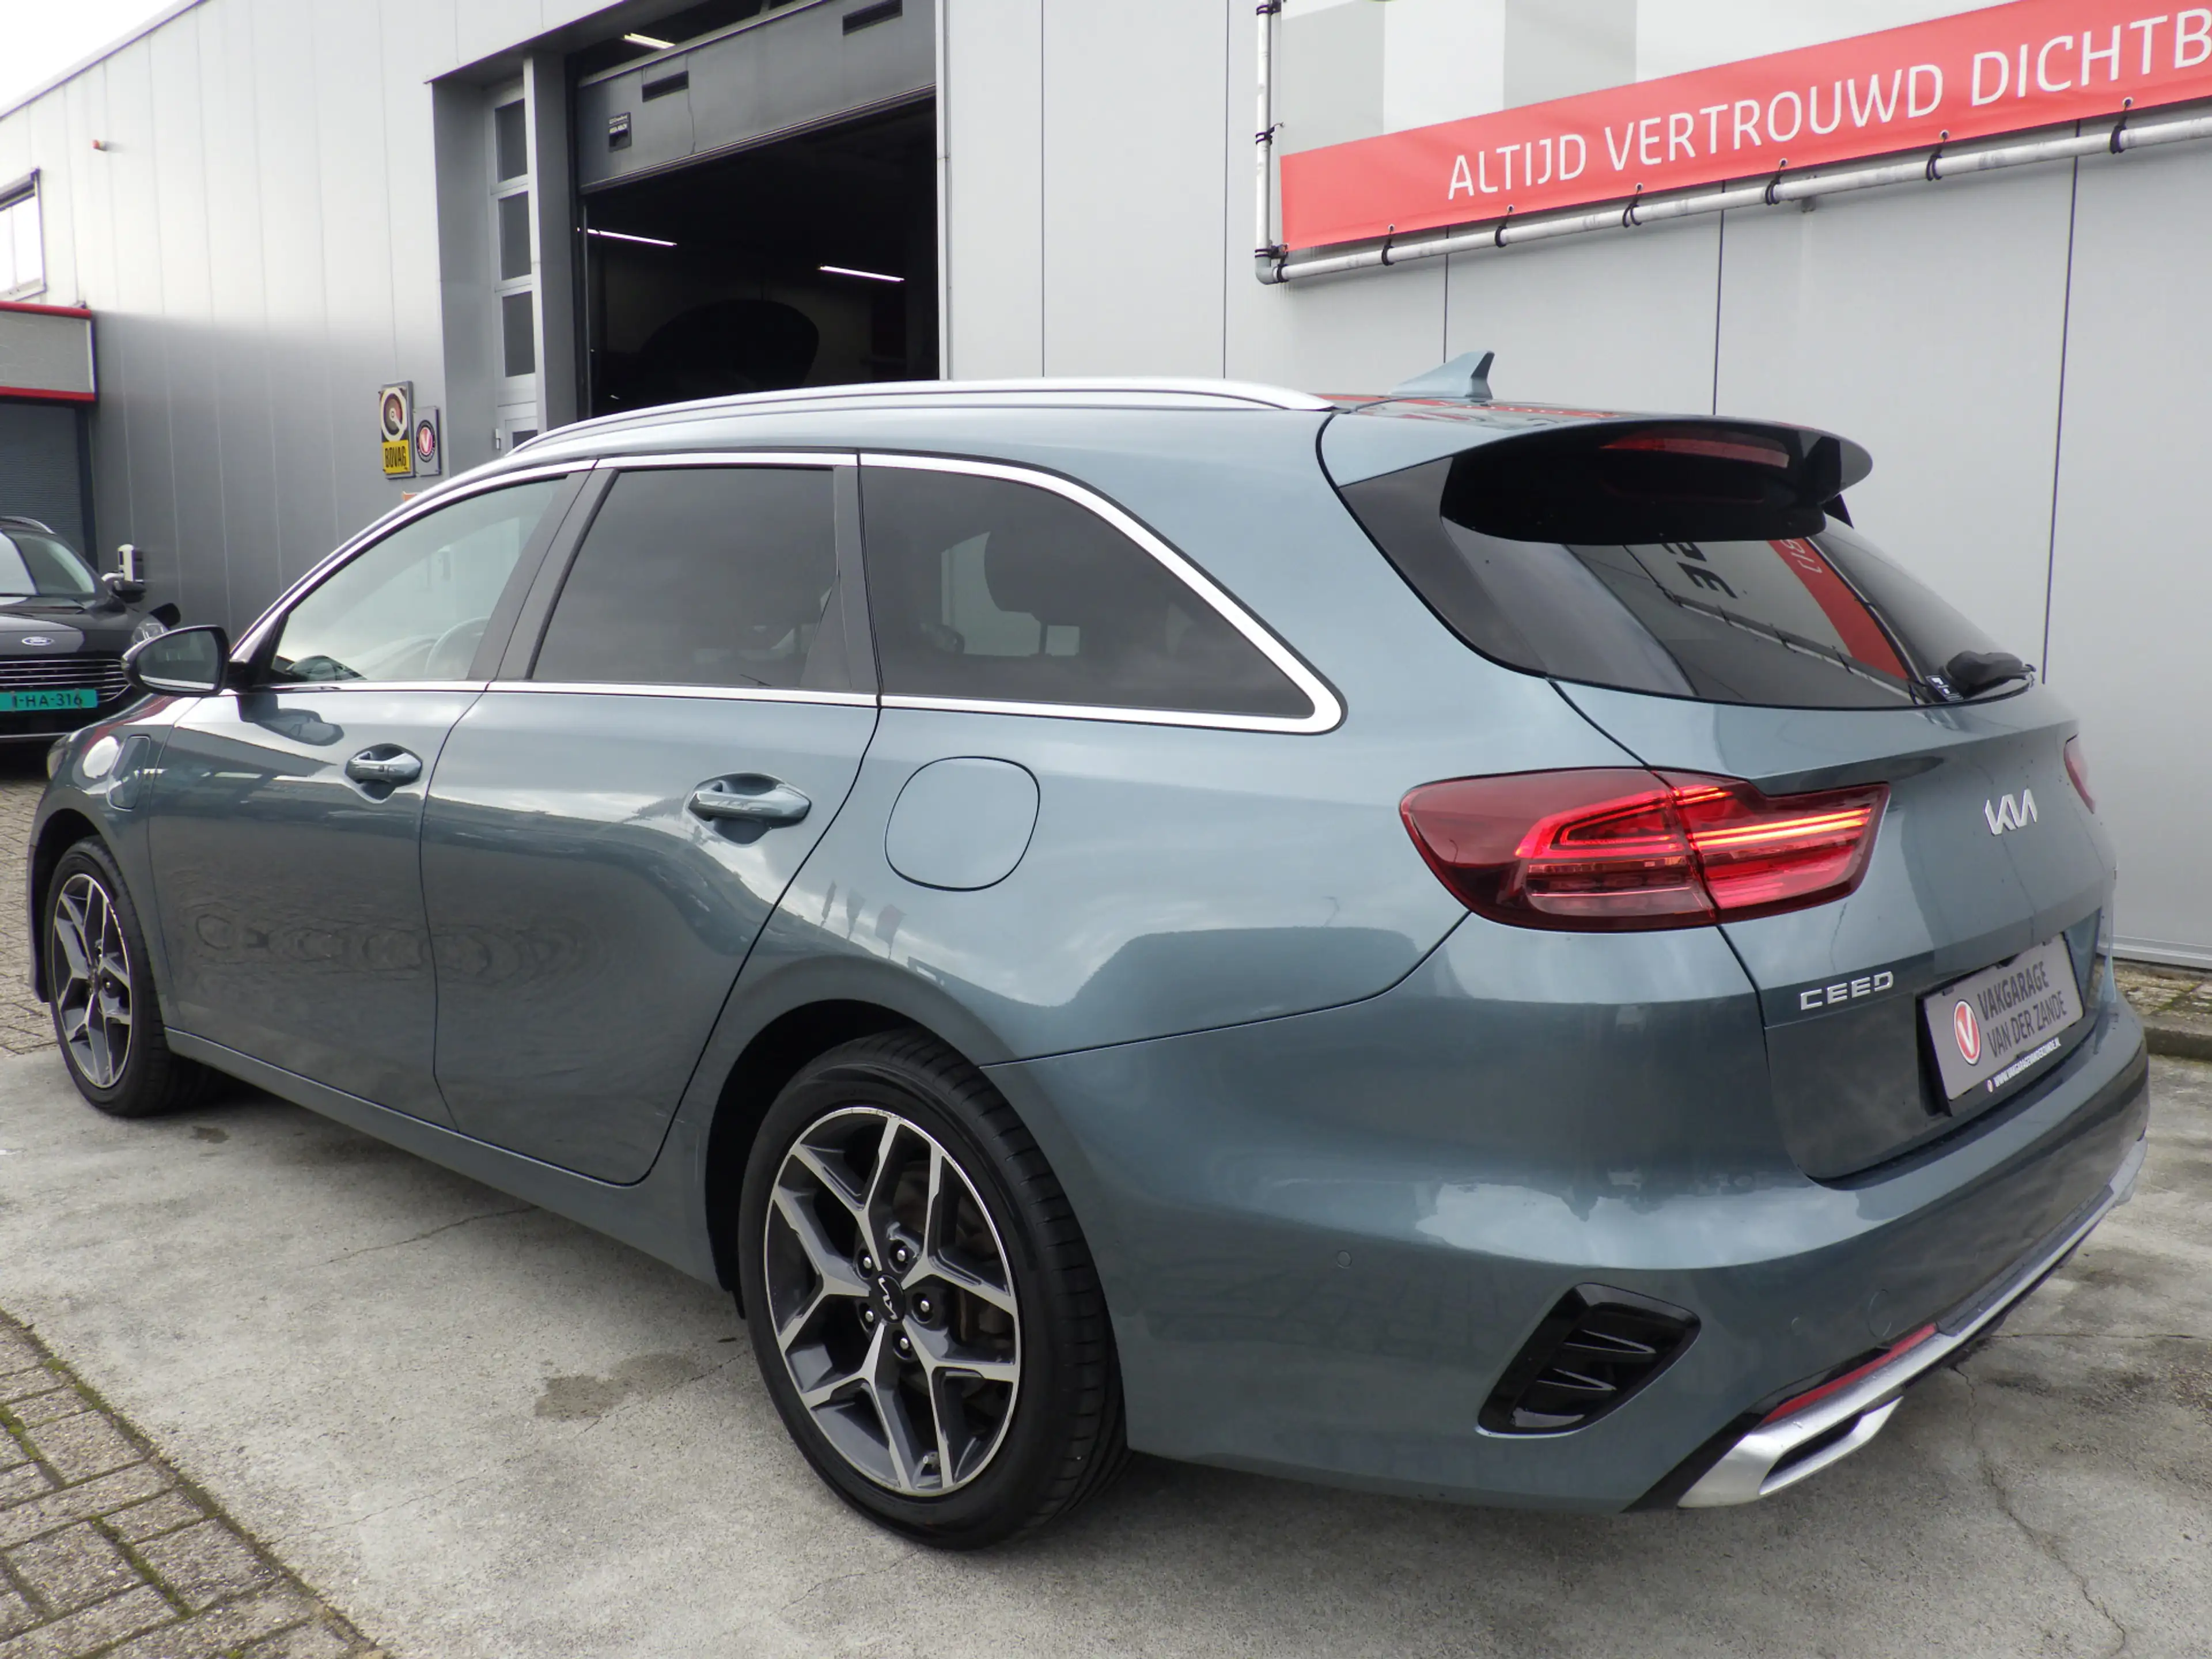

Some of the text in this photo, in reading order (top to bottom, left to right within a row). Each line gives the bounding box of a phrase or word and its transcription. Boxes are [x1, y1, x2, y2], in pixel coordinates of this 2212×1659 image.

[1448, 8, 2212, 200] ALTIJD VERTROUWD DICHTB
[385, 445, 407, 468] BOVAG
[1800, 971, 1894, 1010] CEED
[1977, 961, 2050, 1021] VAKGARAGE
[1986, 990, 2067, 1058] VAN DER ZANDE
